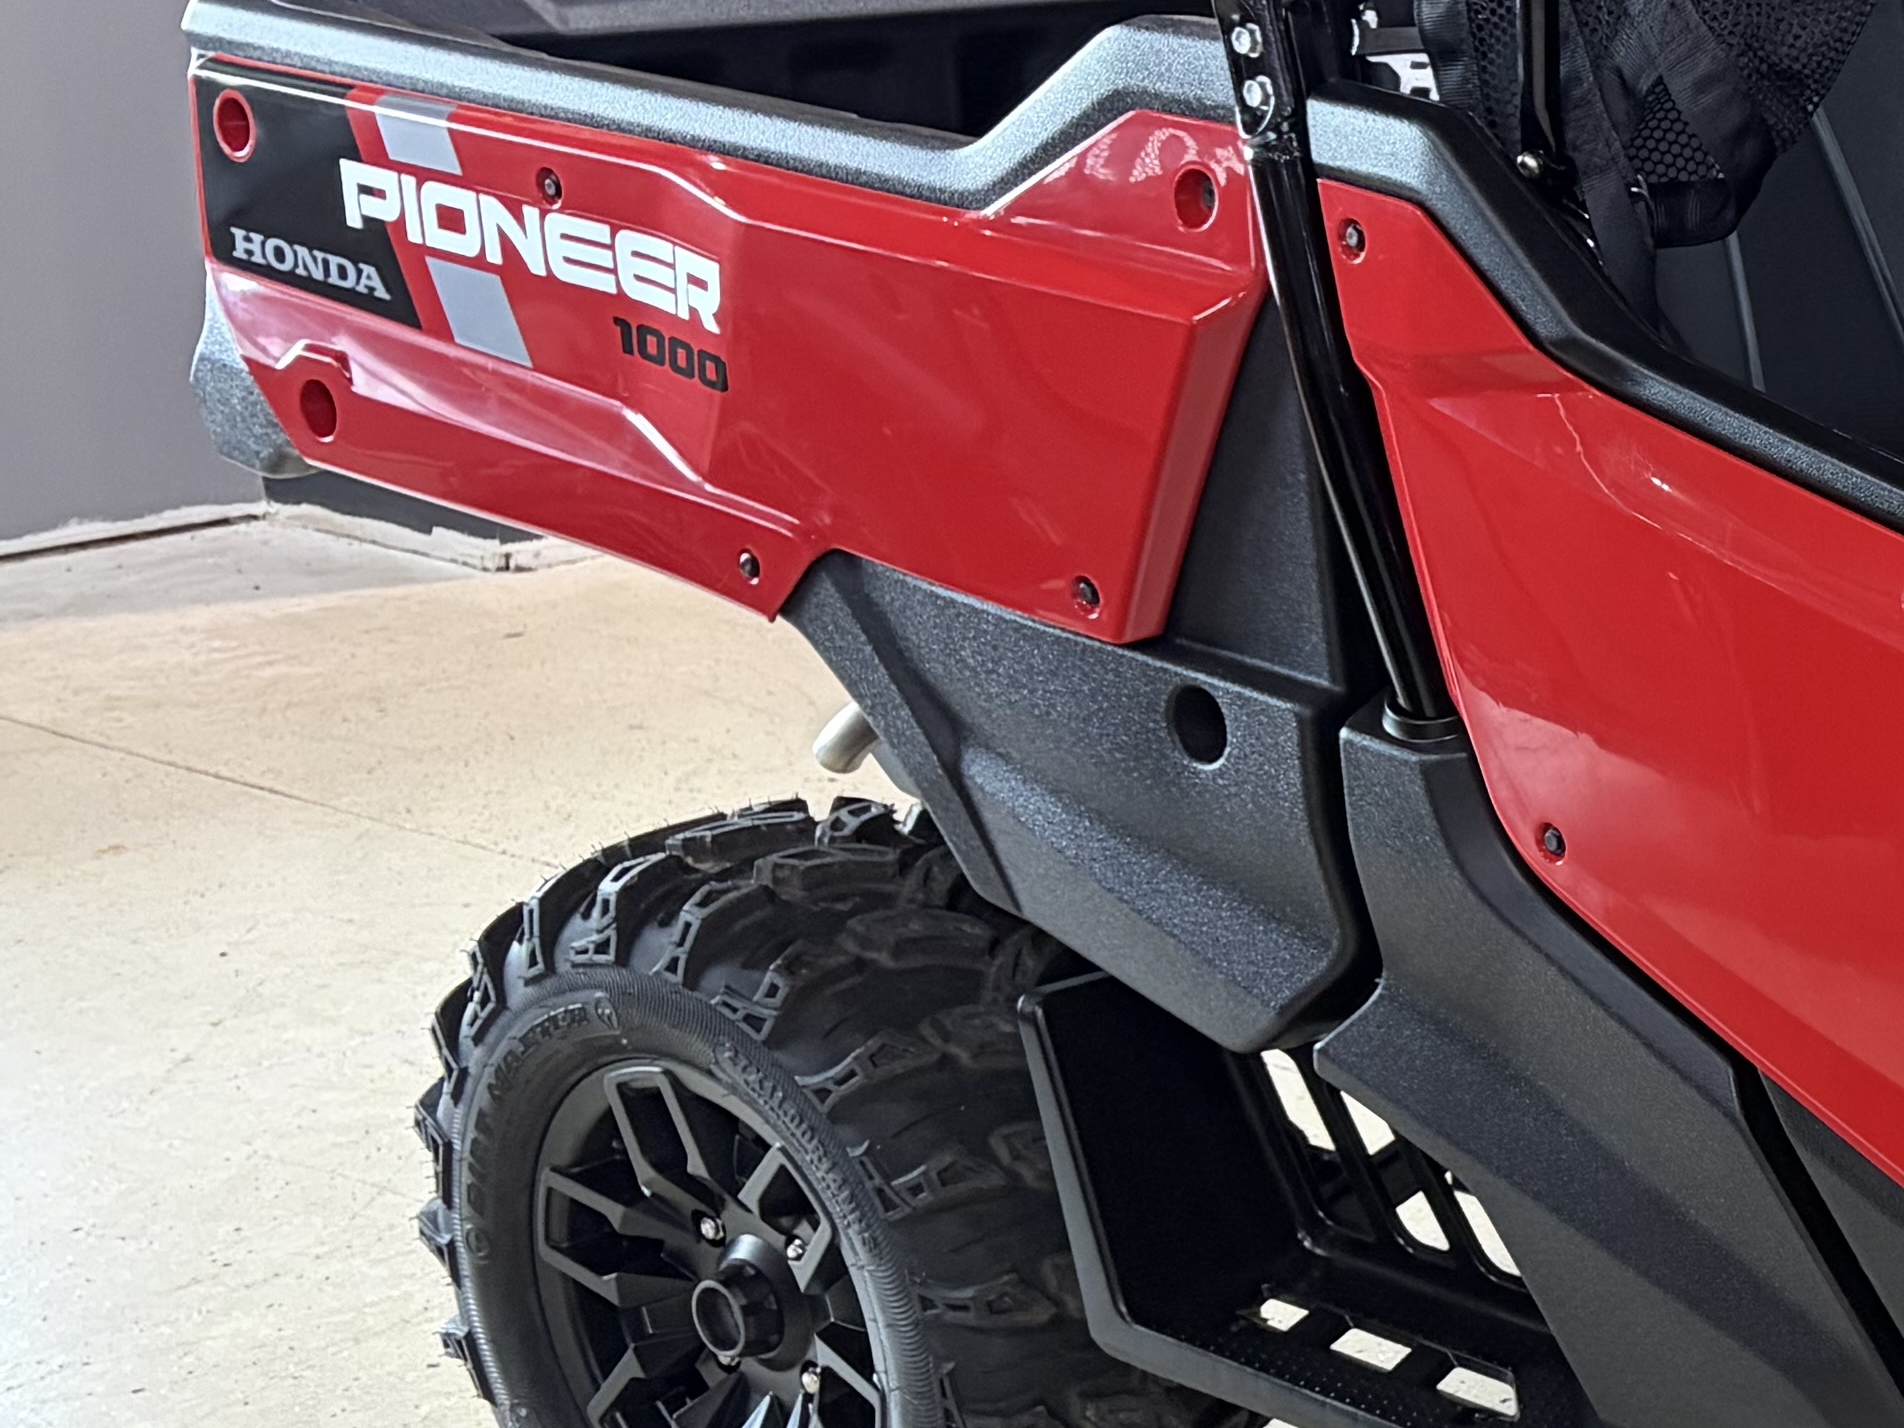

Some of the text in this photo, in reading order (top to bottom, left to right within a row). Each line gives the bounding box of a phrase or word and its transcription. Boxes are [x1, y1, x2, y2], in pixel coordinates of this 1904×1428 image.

[229, 225, 393, 301] HONDA
[337, 157, 722, 334] PIONEER
[612, 315, 730, 393] 1000
